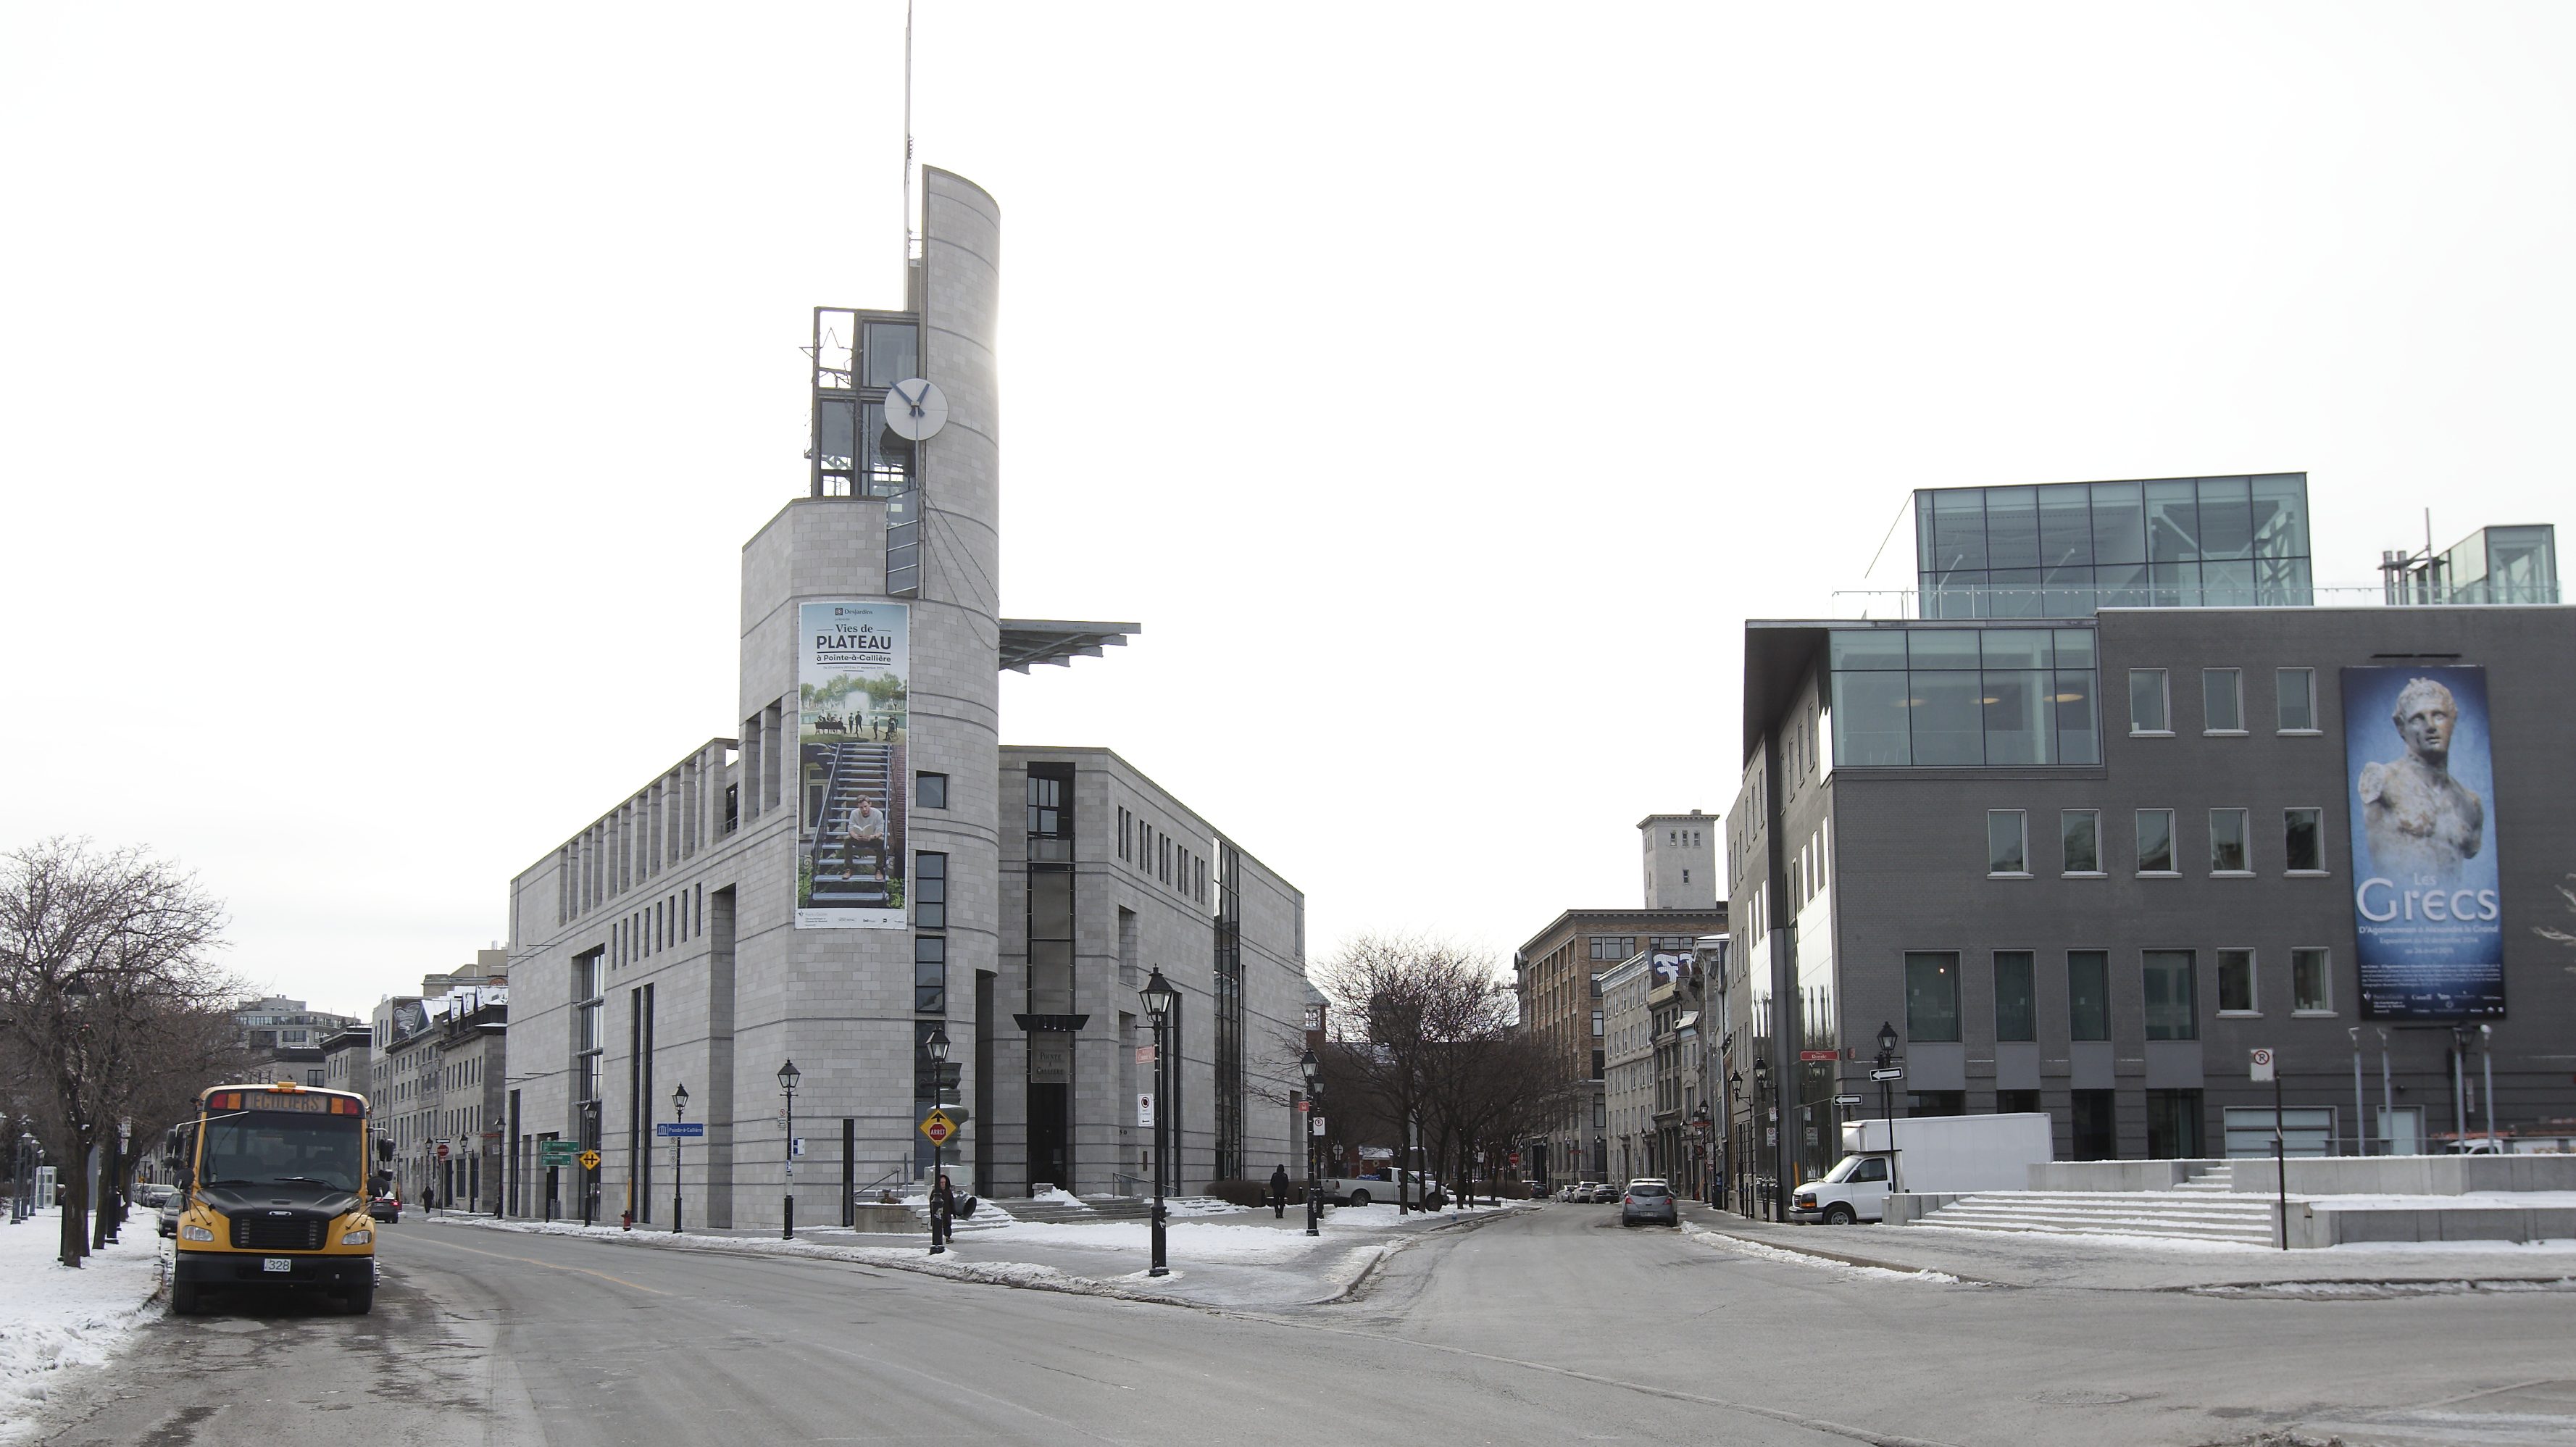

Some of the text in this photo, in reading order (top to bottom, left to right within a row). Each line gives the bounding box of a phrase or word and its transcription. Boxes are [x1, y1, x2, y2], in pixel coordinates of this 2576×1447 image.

[835, 624, 858, 633] Vies
[817, 635, 891, 650] PLATEAU
[2414, 872, 2437, 885] Les
[2356, 877, 2498, 922] Grecs
[269, 1259, 290, 1270] 328
